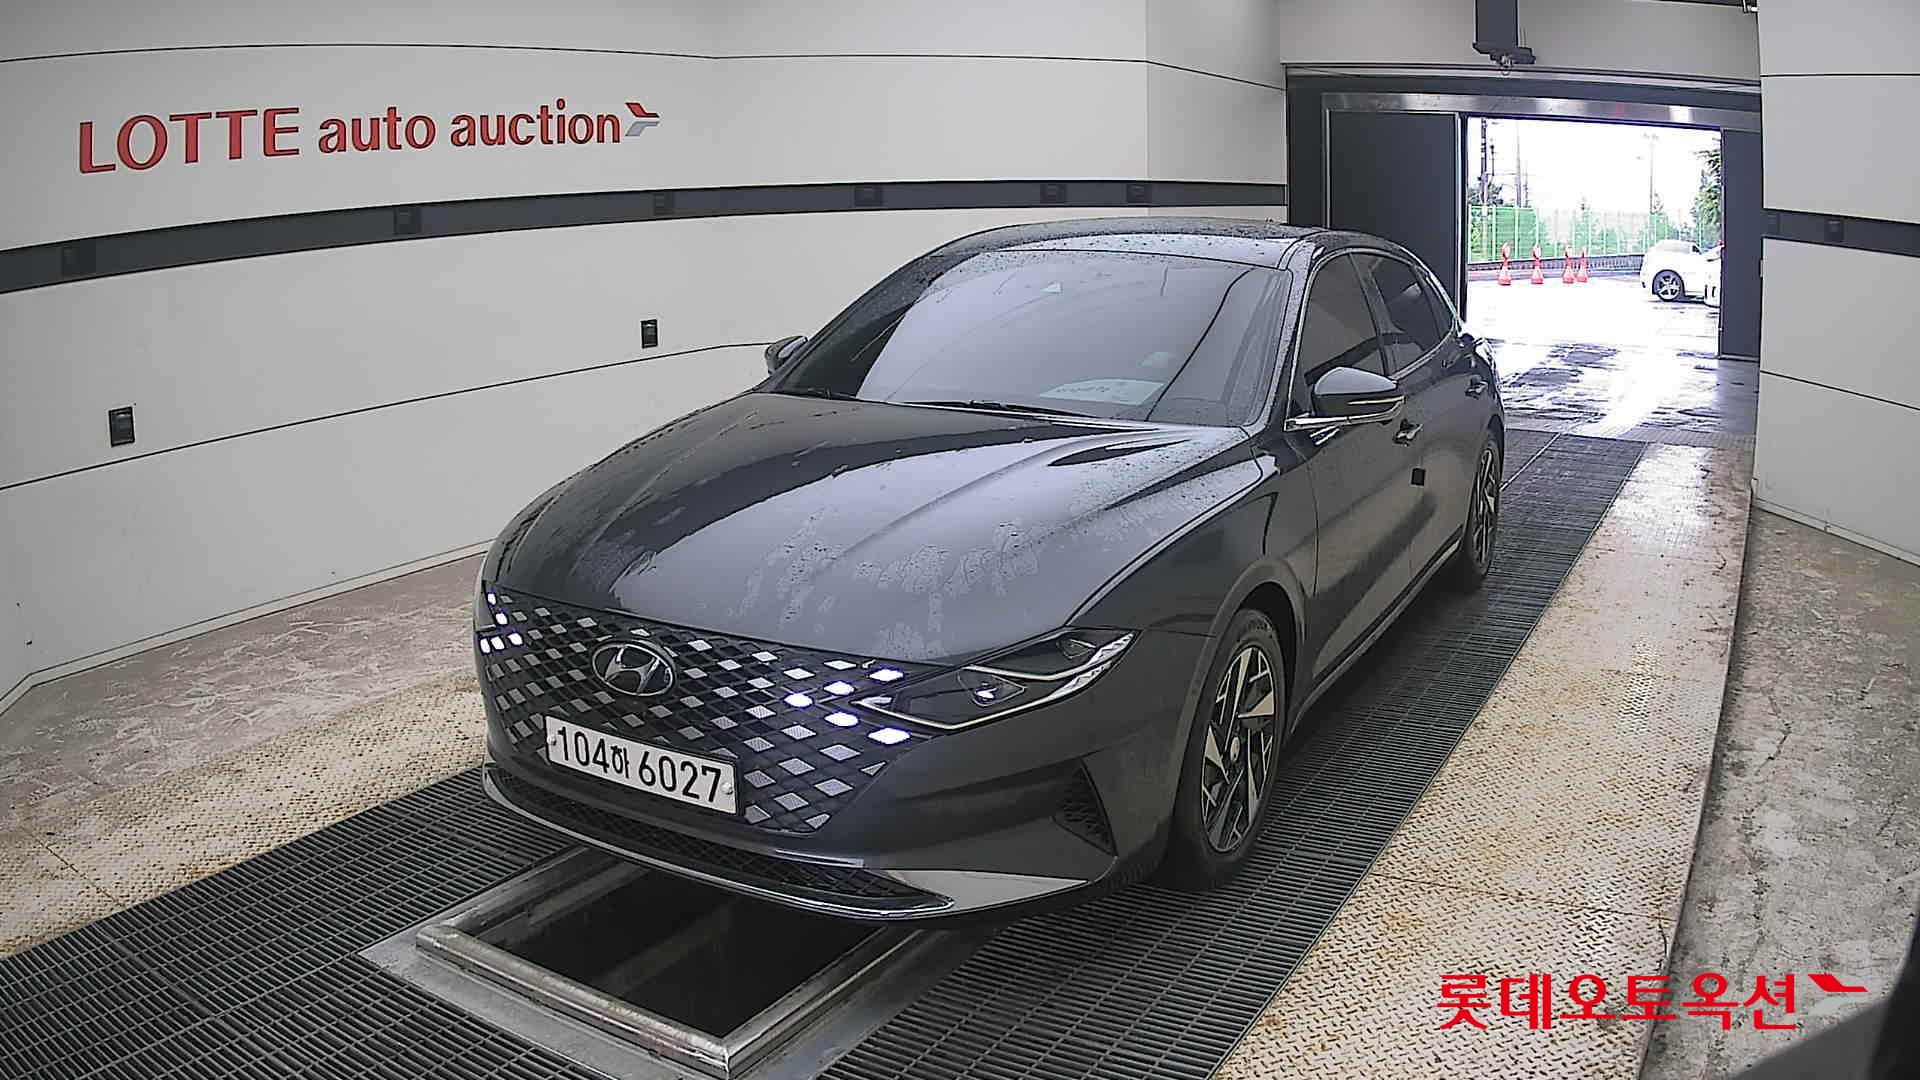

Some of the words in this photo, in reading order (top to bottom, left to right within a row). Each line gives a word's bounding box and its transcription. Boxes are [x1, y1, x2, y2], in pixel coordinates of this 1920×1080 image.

[78, 106, 301, 174] LOTTE
[318, 106, 437, 153] auto
[450, 98, 622, 147] auction
[557, 726, 630, 779] 104하
[638, 751, 722, 803] 6027
